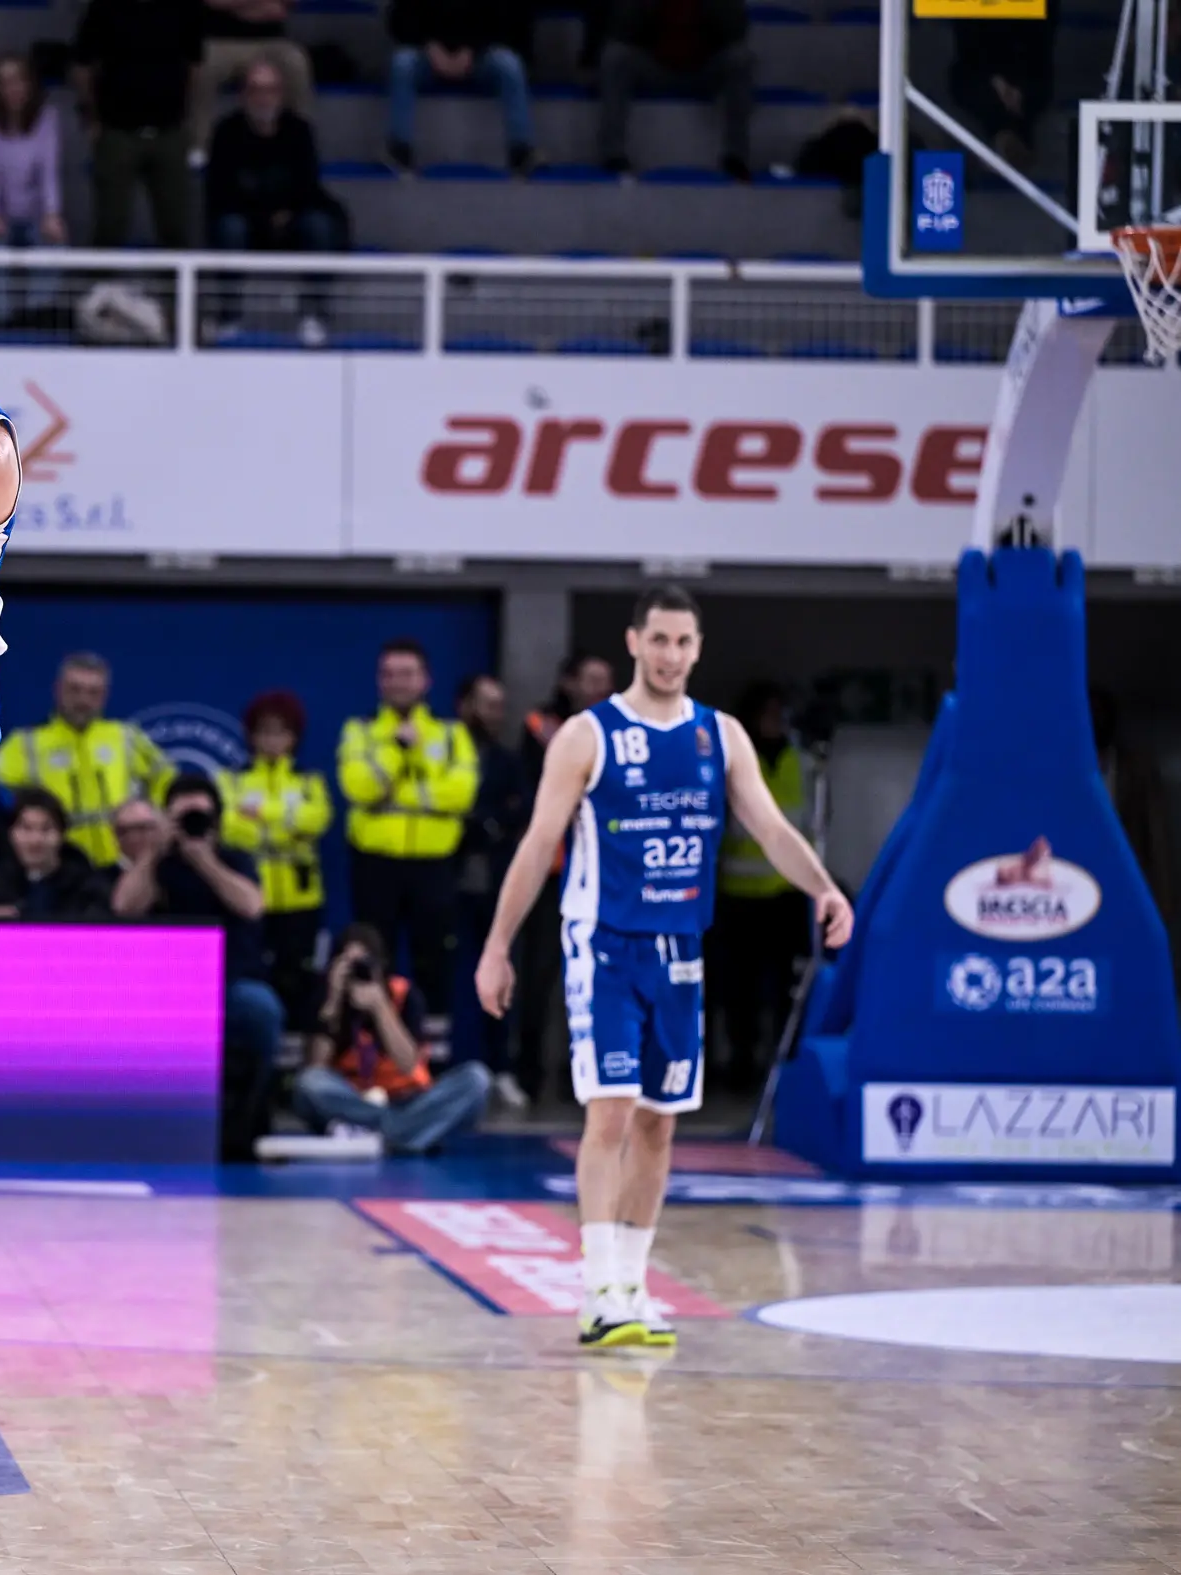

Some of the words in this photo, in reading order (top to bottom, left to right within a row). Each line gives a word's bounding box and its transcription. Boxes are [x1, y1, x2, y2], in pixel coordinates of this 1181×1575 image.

[419, 415, 989, 505] arcese
[611, 726, 650, 766] 18
[643, 836, 703, 868] a2a
[1006, 957, 1097, 998] a2a
[662, 1059, 693, 1095] 18
[931, 1089, 1157, 1139] LAZZARI
